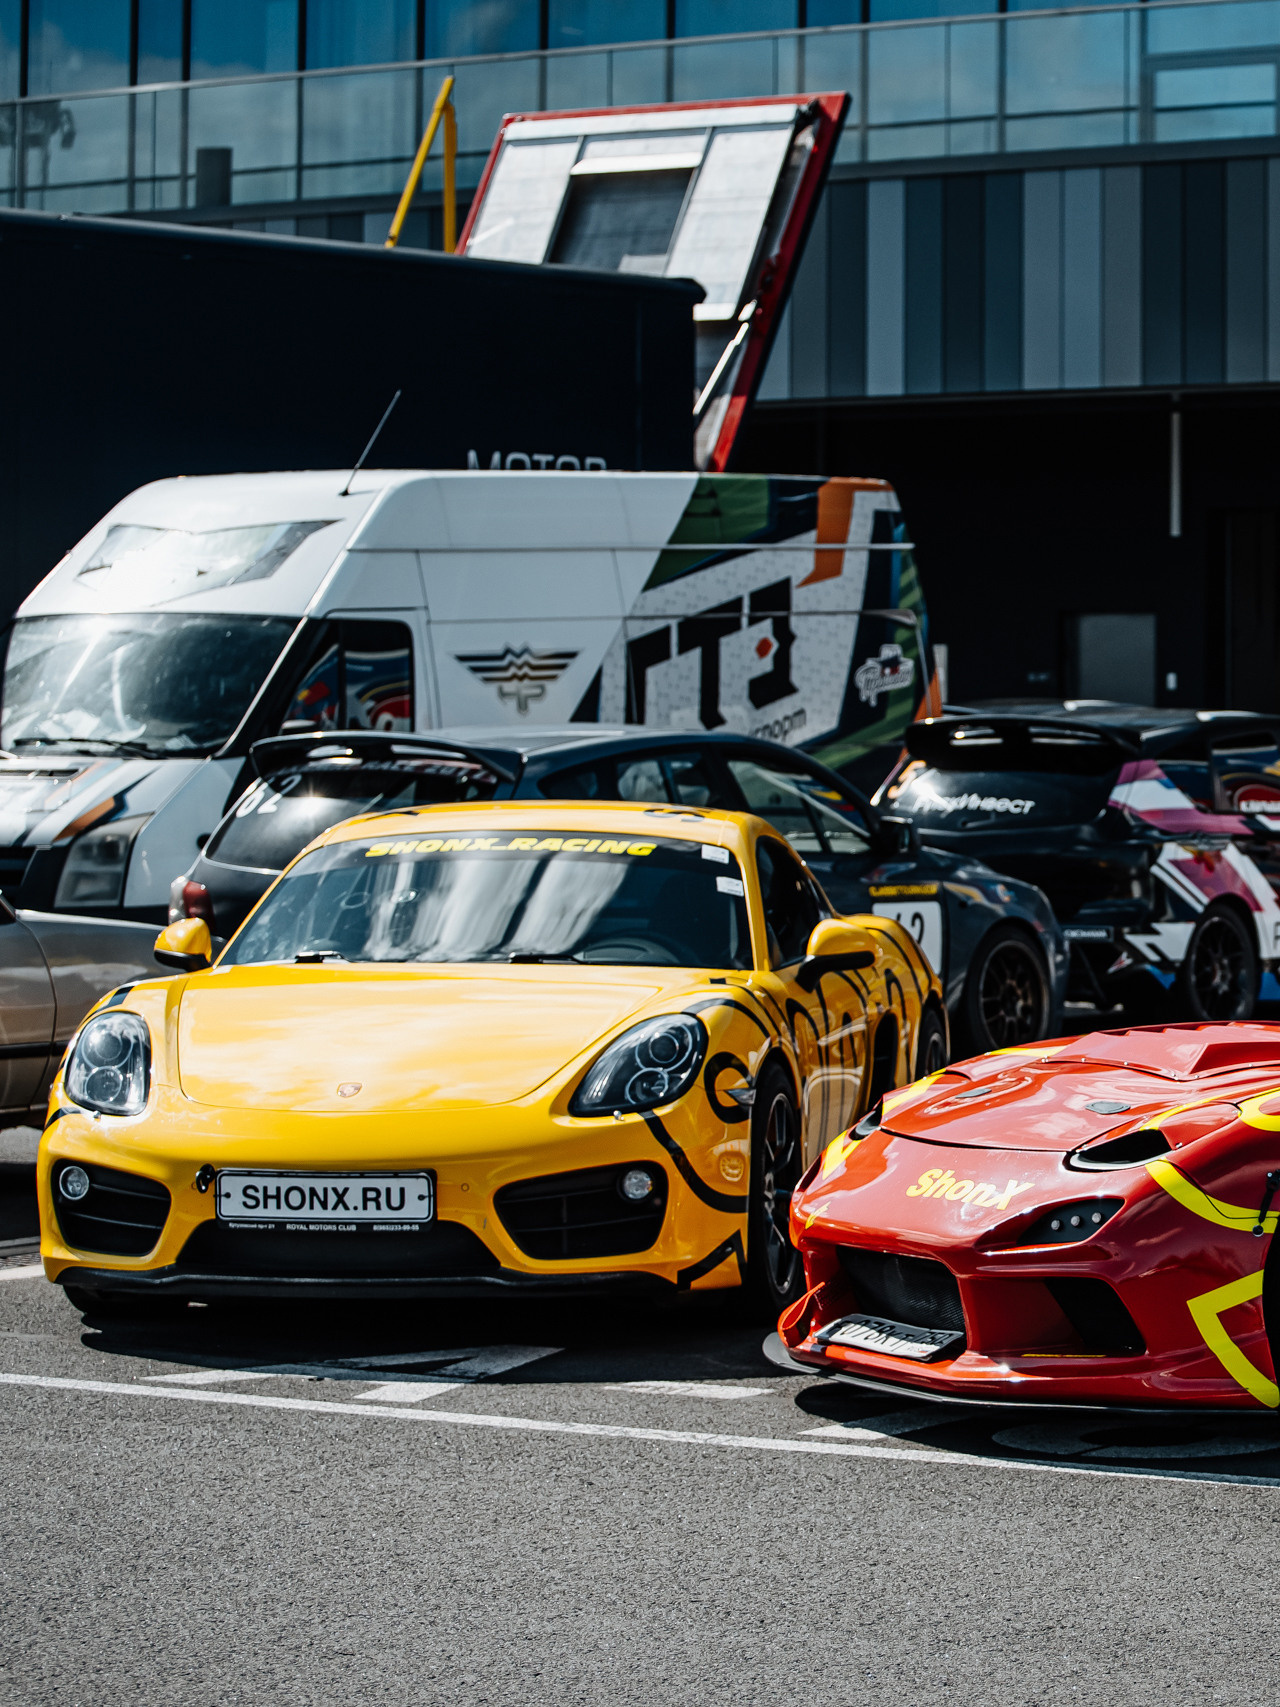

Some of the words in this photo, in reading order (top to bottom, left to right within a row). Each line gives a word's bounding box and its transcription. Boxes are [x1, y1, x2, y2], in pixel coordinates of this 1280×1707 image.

[365, 837, 657, 857] SHONX_RACING
[896, 912, 925, 945] 2
[241, 1184, 406, 1211] SHONX.RU
[906, 1168, 1036, 1211] ShonX
